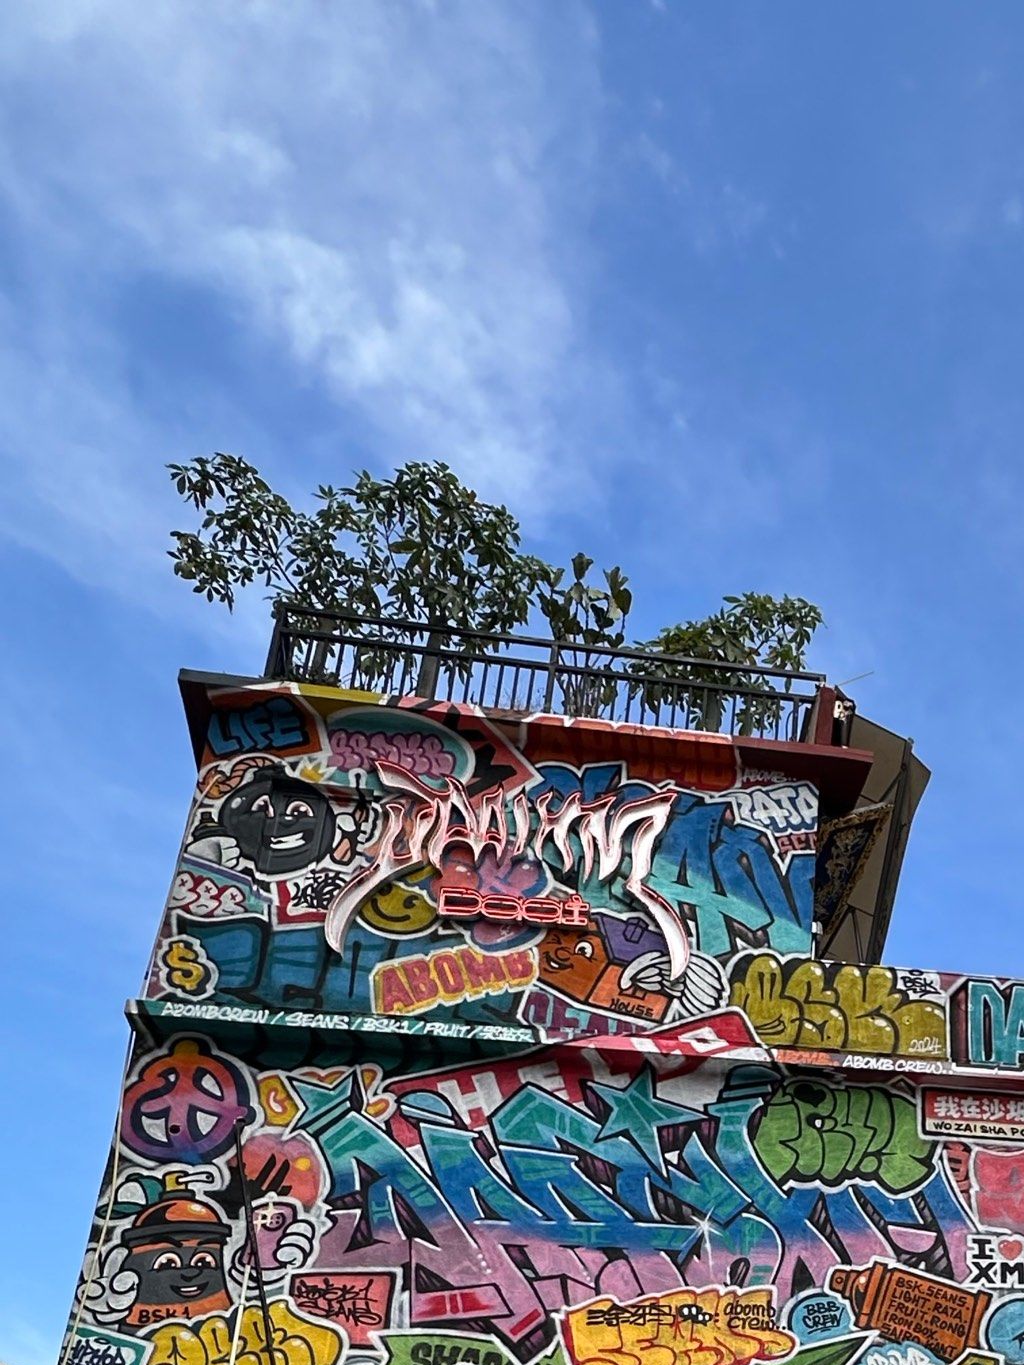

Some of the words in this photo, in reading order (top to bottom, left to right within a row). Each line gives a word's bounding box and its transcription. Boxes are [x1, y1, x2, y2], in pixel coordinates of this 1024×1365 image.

[207, 700, 304, 756] LIFE
[380, 948, 535, 1013] ABOMB
[609, 997, 655, 1018] HOUSE
[423, 1021, 471, 1038] FRUIT
[908, 1037, 943, 1054] 2024
[842, 1055, 894, 1071] ABOMB
[932, 1121, 952, 1132] WO
[953, 1122, 978, 1134] ZAI
[979, 1124, 1008, 1136] SHA
[972, 1238, 993, 1260] I
[971, 1261, 1024, 1284] XM
[724, 1300, 776, 1318] abomb
[803, 1301, 840, 1316] BBB
[803, 1309, 845, 1330] CREW
